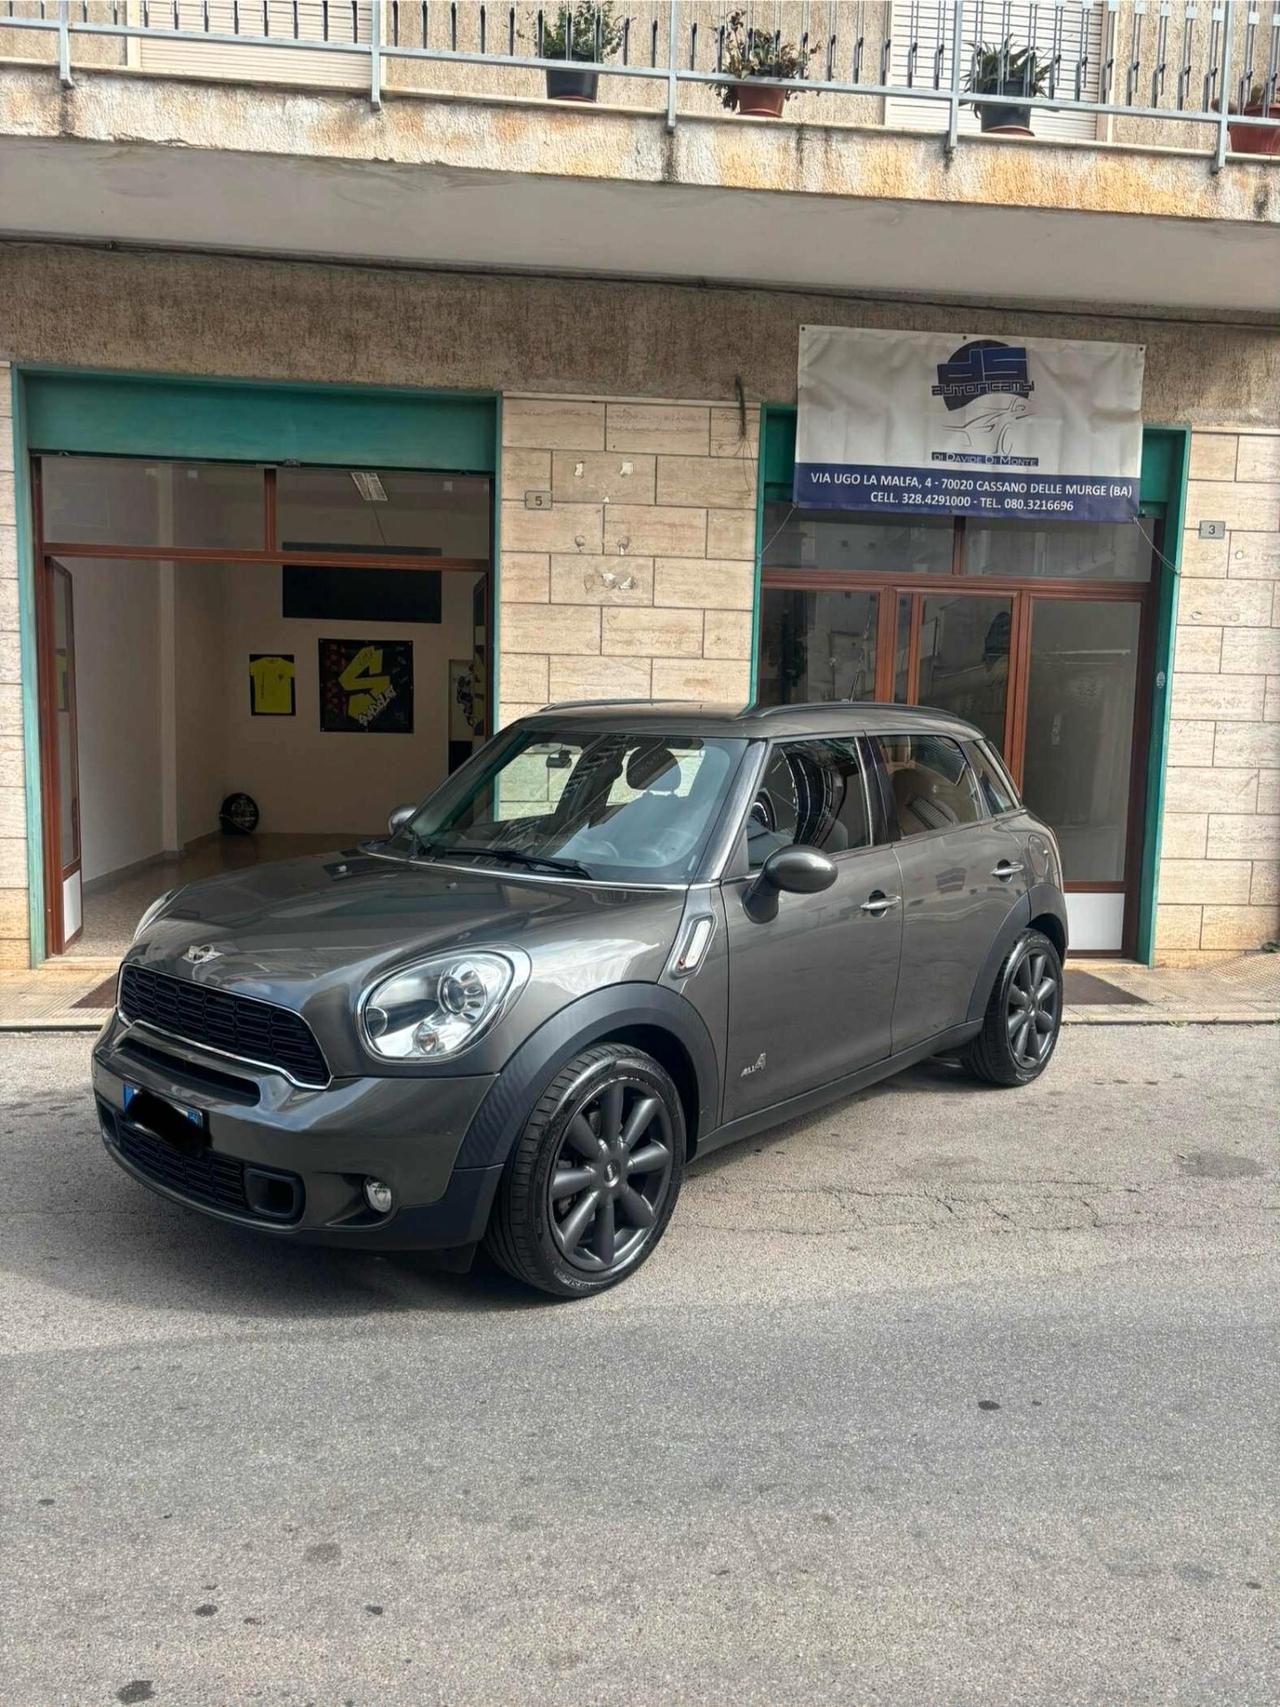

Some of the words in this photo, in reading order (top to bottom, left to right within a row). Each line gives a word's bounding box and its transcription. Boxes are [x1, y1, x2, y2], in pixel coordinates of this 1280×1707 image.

[946, 452, 983, 464] DAVIDE
[985, 455, 997, 465] DI
[999, 456, 1038, 466] MONTE
[811, 472, 831, 484] VIA
[834, 473, 861, 485] UGO
[863, 474, 878, 486] LA
[880, 475, 922, 489] MALFA,
[924, 478, 932, 488] 4
[941, 479, 974, 491] 70020
[976, 480, 1027, 493] CASSANO
[1030, 483, 1062, 495] DELLE
[1065, 484, 1107, 496] MURGE
[1109, 485, 1132, 498] (BA)
[535, 495, 543, 507] 5
[870, 491, 899, 503] CELL.
[901, 493, 971, 507] 328.4291000
[979, 497, 1001, 509] TEL.
[1004, 498, 1074, 511] 080.3216696
[1208, 524, 1216, 535] 3
